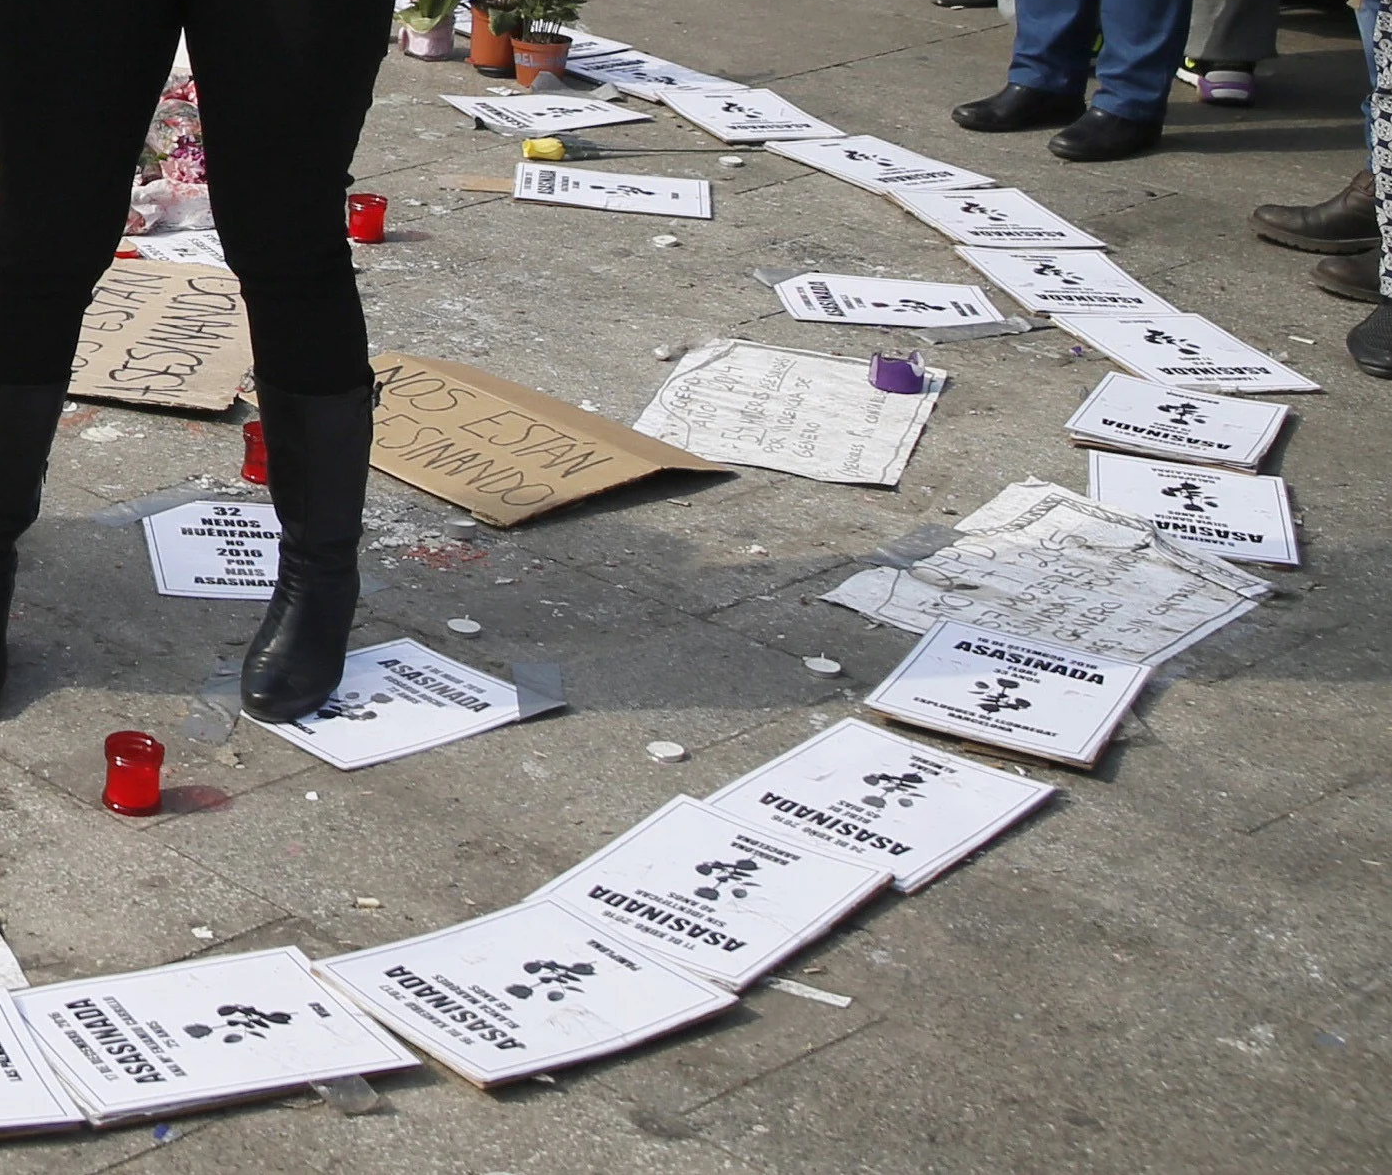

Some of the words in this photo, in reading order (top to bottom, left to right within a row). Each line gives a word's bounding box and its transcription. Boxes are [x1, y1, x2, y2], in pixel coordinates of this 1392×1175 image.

[1036, 292, 1145, 305] ASASINADA
[375, 365, 476, 413] NOS
[459, 409, 614, 478] ESTÁN
[1102, 418, 1232, 450] ASASINADA
[200, 518, 261, 528] NENOS
[212, 506, 243, 517] 32
[1153, 519, 1264, 544] ASASINA
[216, 548, 263, 558] 2016
[224, 567, 266, 576] NAIS
[953, 639, 1106, 687] ASASINADA
[377, 657, 493, 714] ASASINADA
[946, 709, 1014, 733] BARCELONA
[758, 790, 913, 858] ASASINADA
[586, 884, 749, 953] ASASINADA
[384, 964, 527, 1050] ASASINADA
[65, 997, 167, 1085] ASASINADA
